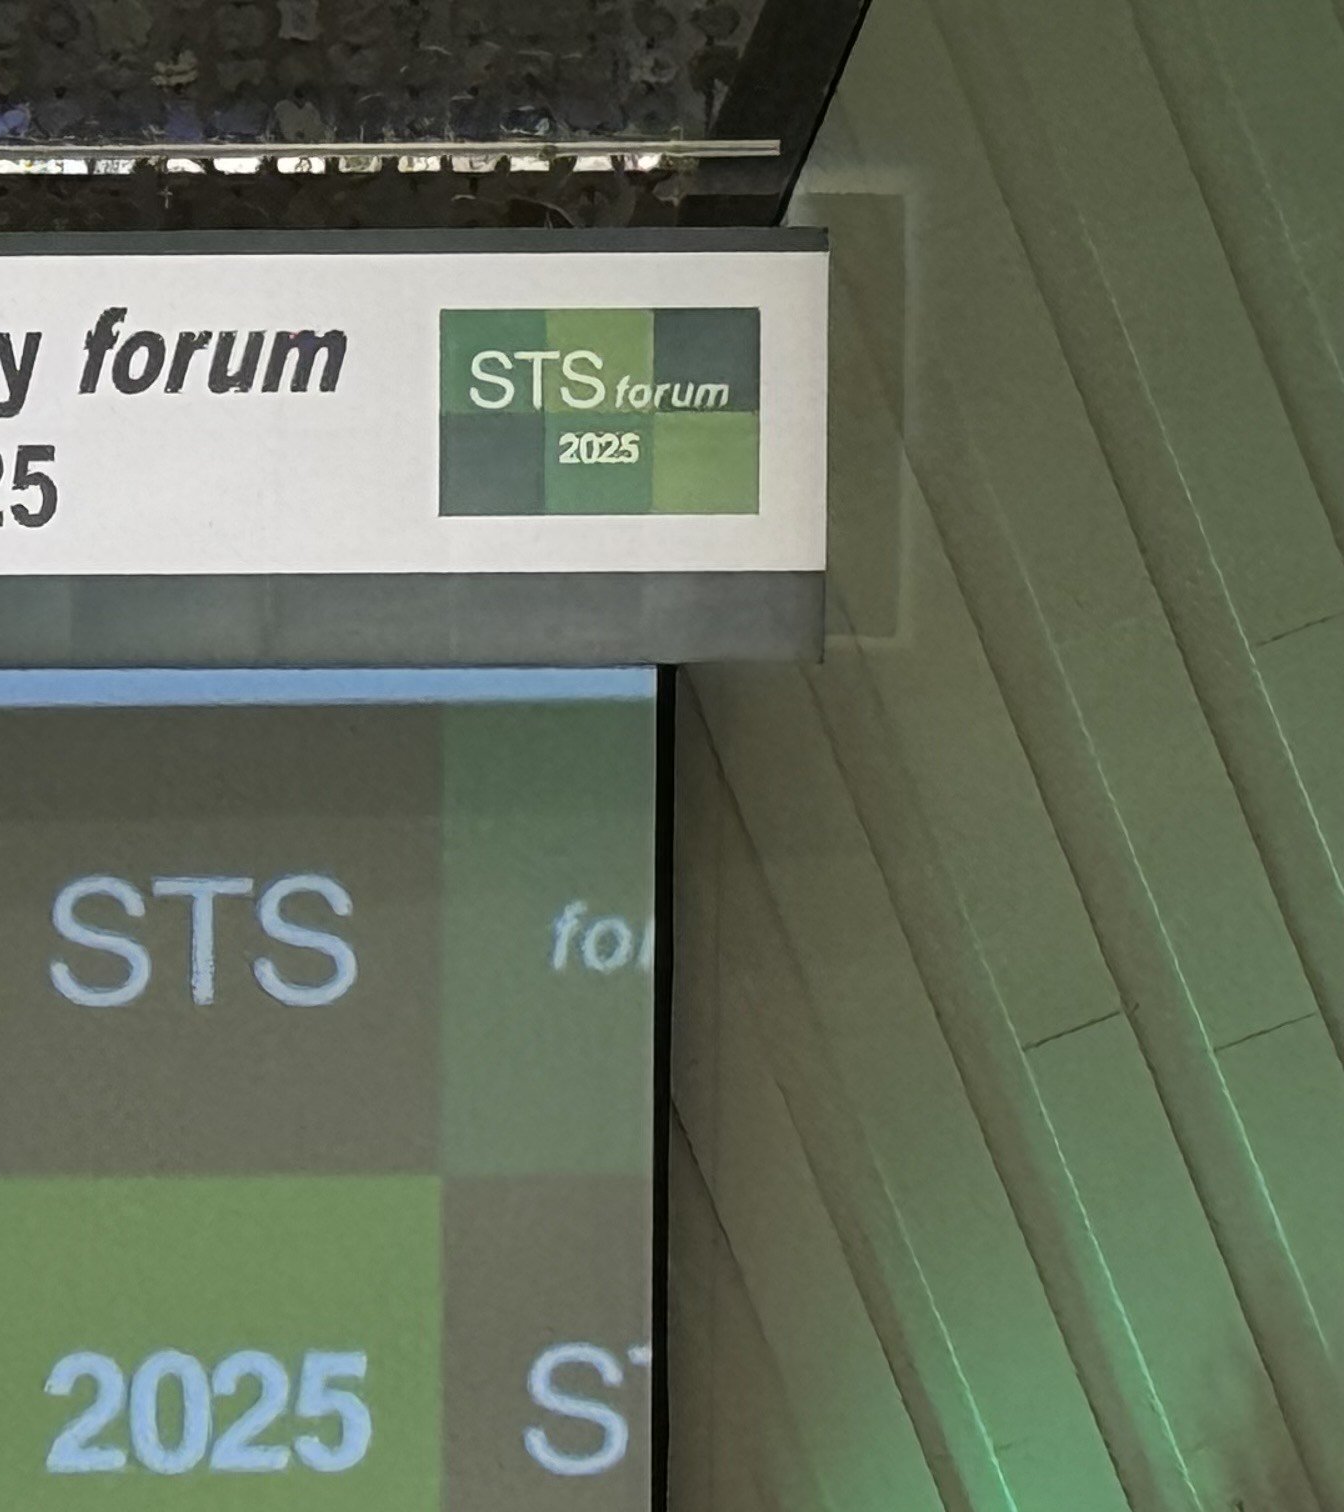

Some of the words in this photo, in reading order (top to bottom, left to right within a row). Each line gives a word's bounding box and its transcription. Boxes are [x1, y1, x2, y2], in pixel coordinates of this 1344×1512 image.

[80, 308, 347, 394] forum
[470, 351, 605, 409] STS
[616, 375, 729, 408] forum
[559, 433, 640, 463] 2025
[51, 875, 357, 1006] STS
[45, 1351, 372, 1473] 2025
